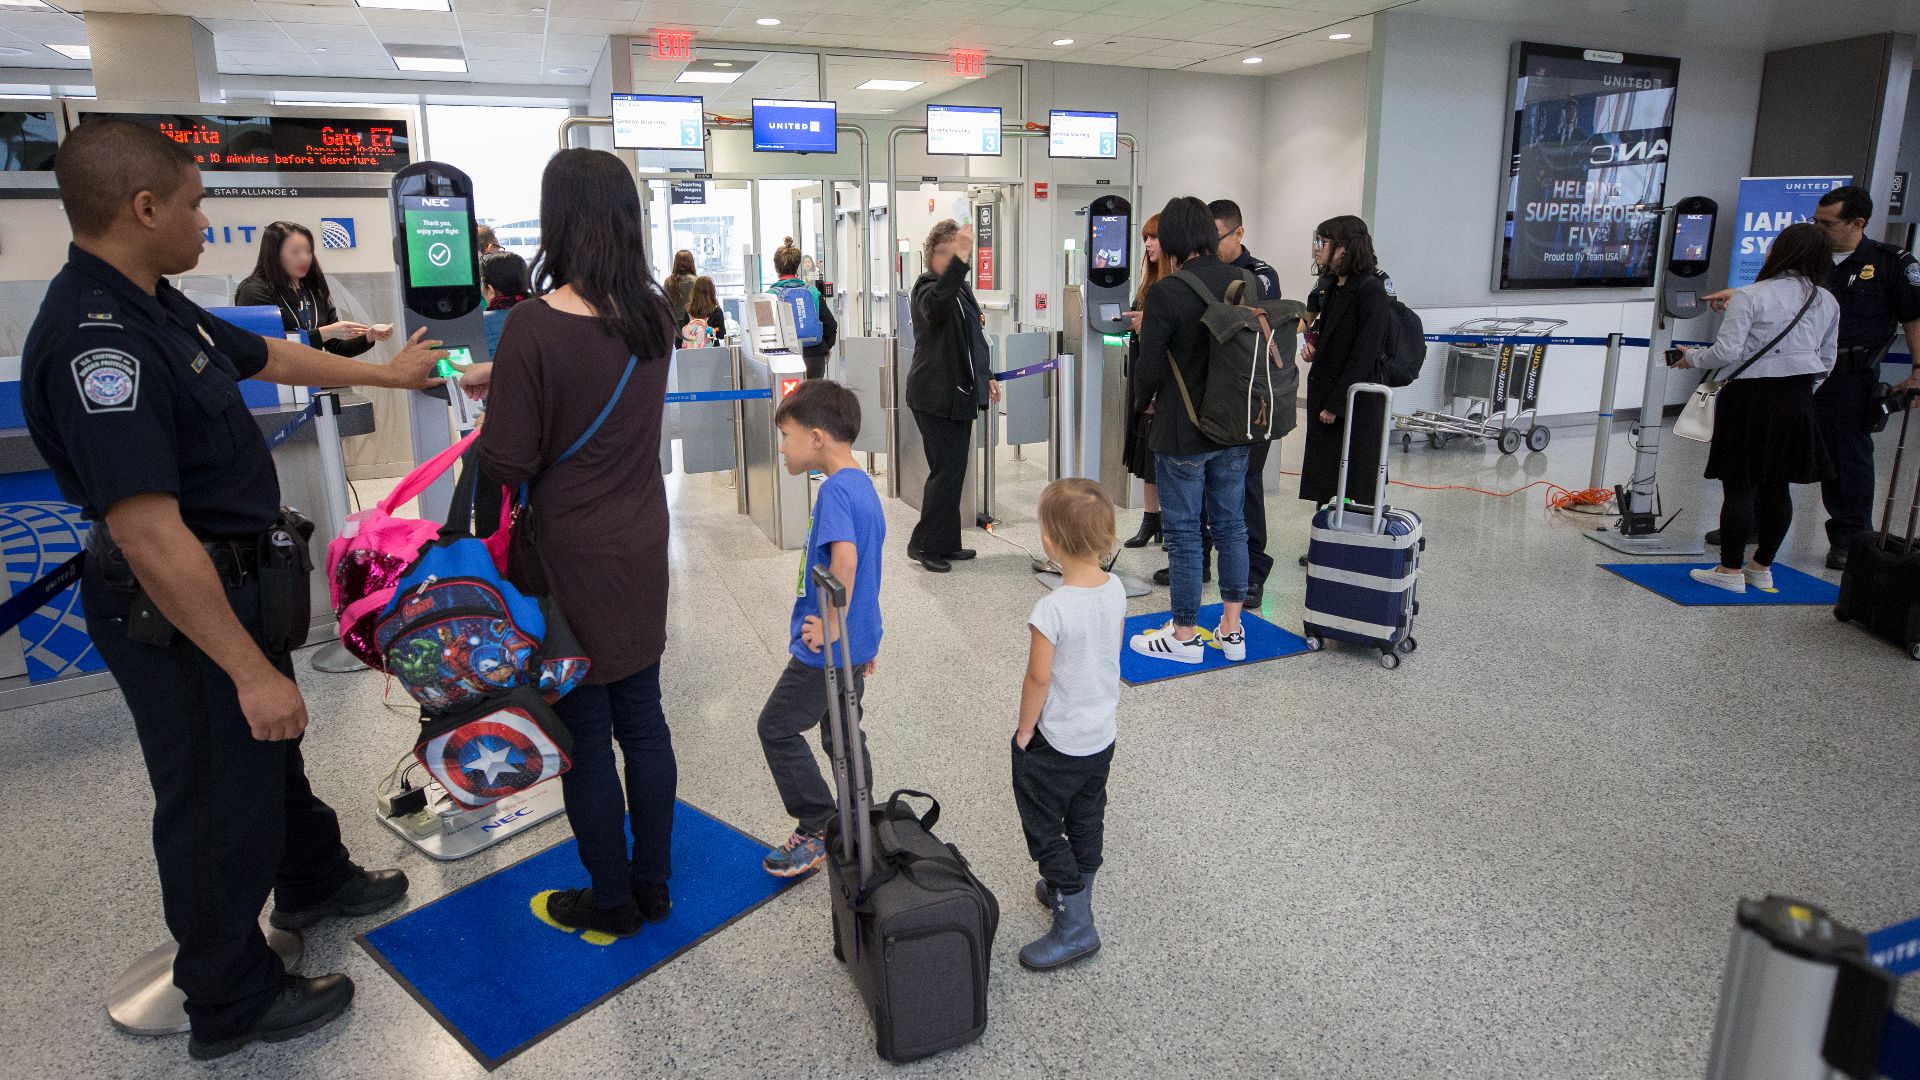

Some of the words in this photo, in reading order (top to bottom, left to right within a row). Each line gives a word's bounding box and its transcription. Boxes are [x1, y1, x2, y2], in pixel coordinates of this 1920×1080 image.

[657, 33, 691, 57] EXIT
[953, 52, 983, 74] EXIT
[1603, 75, 1652, 89] UNITED
[768, 122, 809, 130] UNITED
[321, 126, 361, 146] Gate
[684, 127, 697, 145] 3
[985, 134, 996, 150] 3
[1103, 138, 1112, 154] 3
[226, 154, 269, 164] minutes
[275, 154, 314, 164] before
[320, 155, 379, 165] departure.
[214, 188, 238, 196] STAR
[241, 188, 287, 196] ALLIANCE
[1553, 180, 1622, 198] HELPING
[421, 198, 450, 207] NEC
[1525, 202, 1643, 222] SUPERHEROES
[1744, 211, 1793, 232] IAH
[1568, 226, 1599, 247] FLY
[1740, 236, 1778, 255] SY
[1544, 252, 1565, 262] Proud
[1566, 252, 1574, 261] to
[1576, 251, 1585, 263] fly
[1586, 252, 1604, 261] Team
[1605, 252, 1619, 261] USA
[481, 806, 535, 833] NEC
